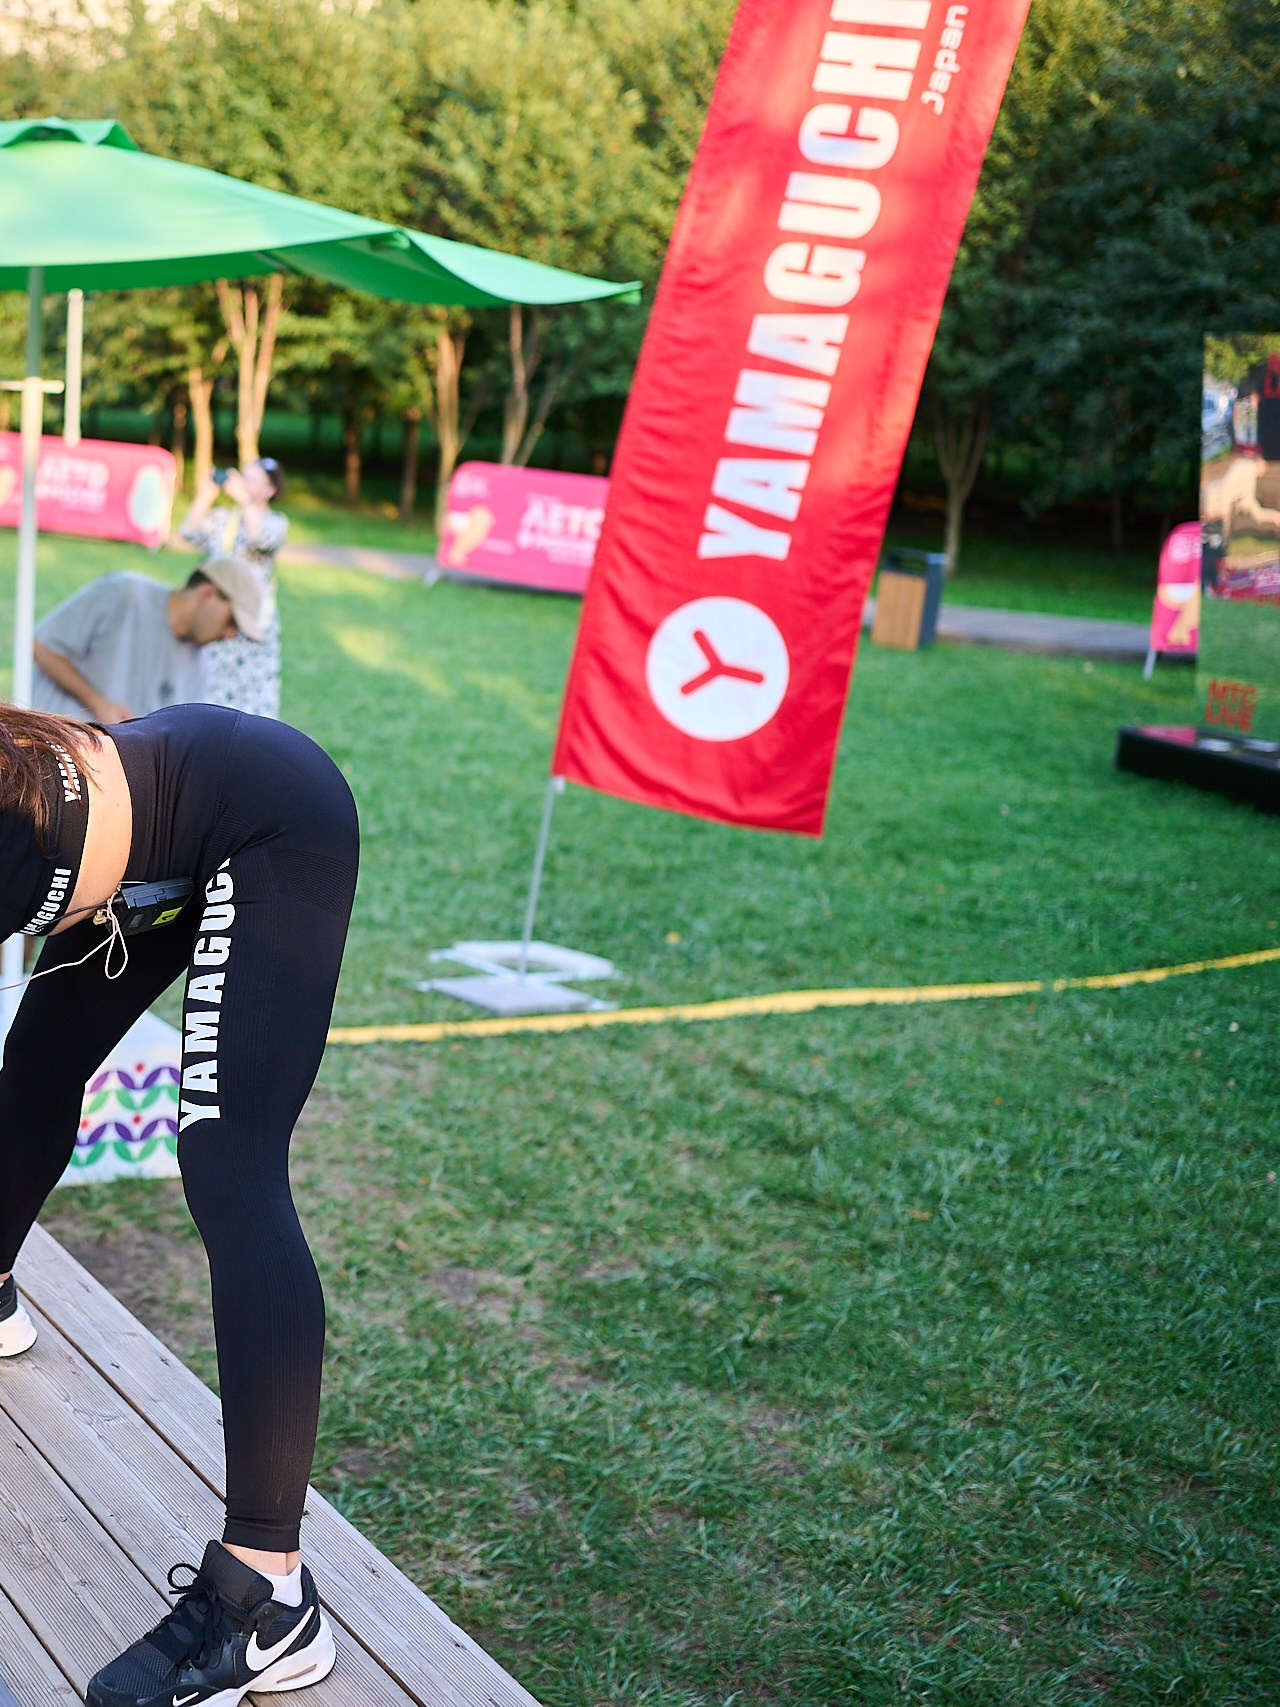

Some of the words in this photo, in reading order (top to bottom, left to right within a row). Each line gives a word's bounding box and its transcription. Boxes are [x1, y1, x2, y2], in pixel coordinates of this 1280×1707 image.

[921, 5, 969, 116] Japan
[698, 0, 932, 562] YAMAGUCHI
[178, 857, 236, 1133] YAMAGUC
